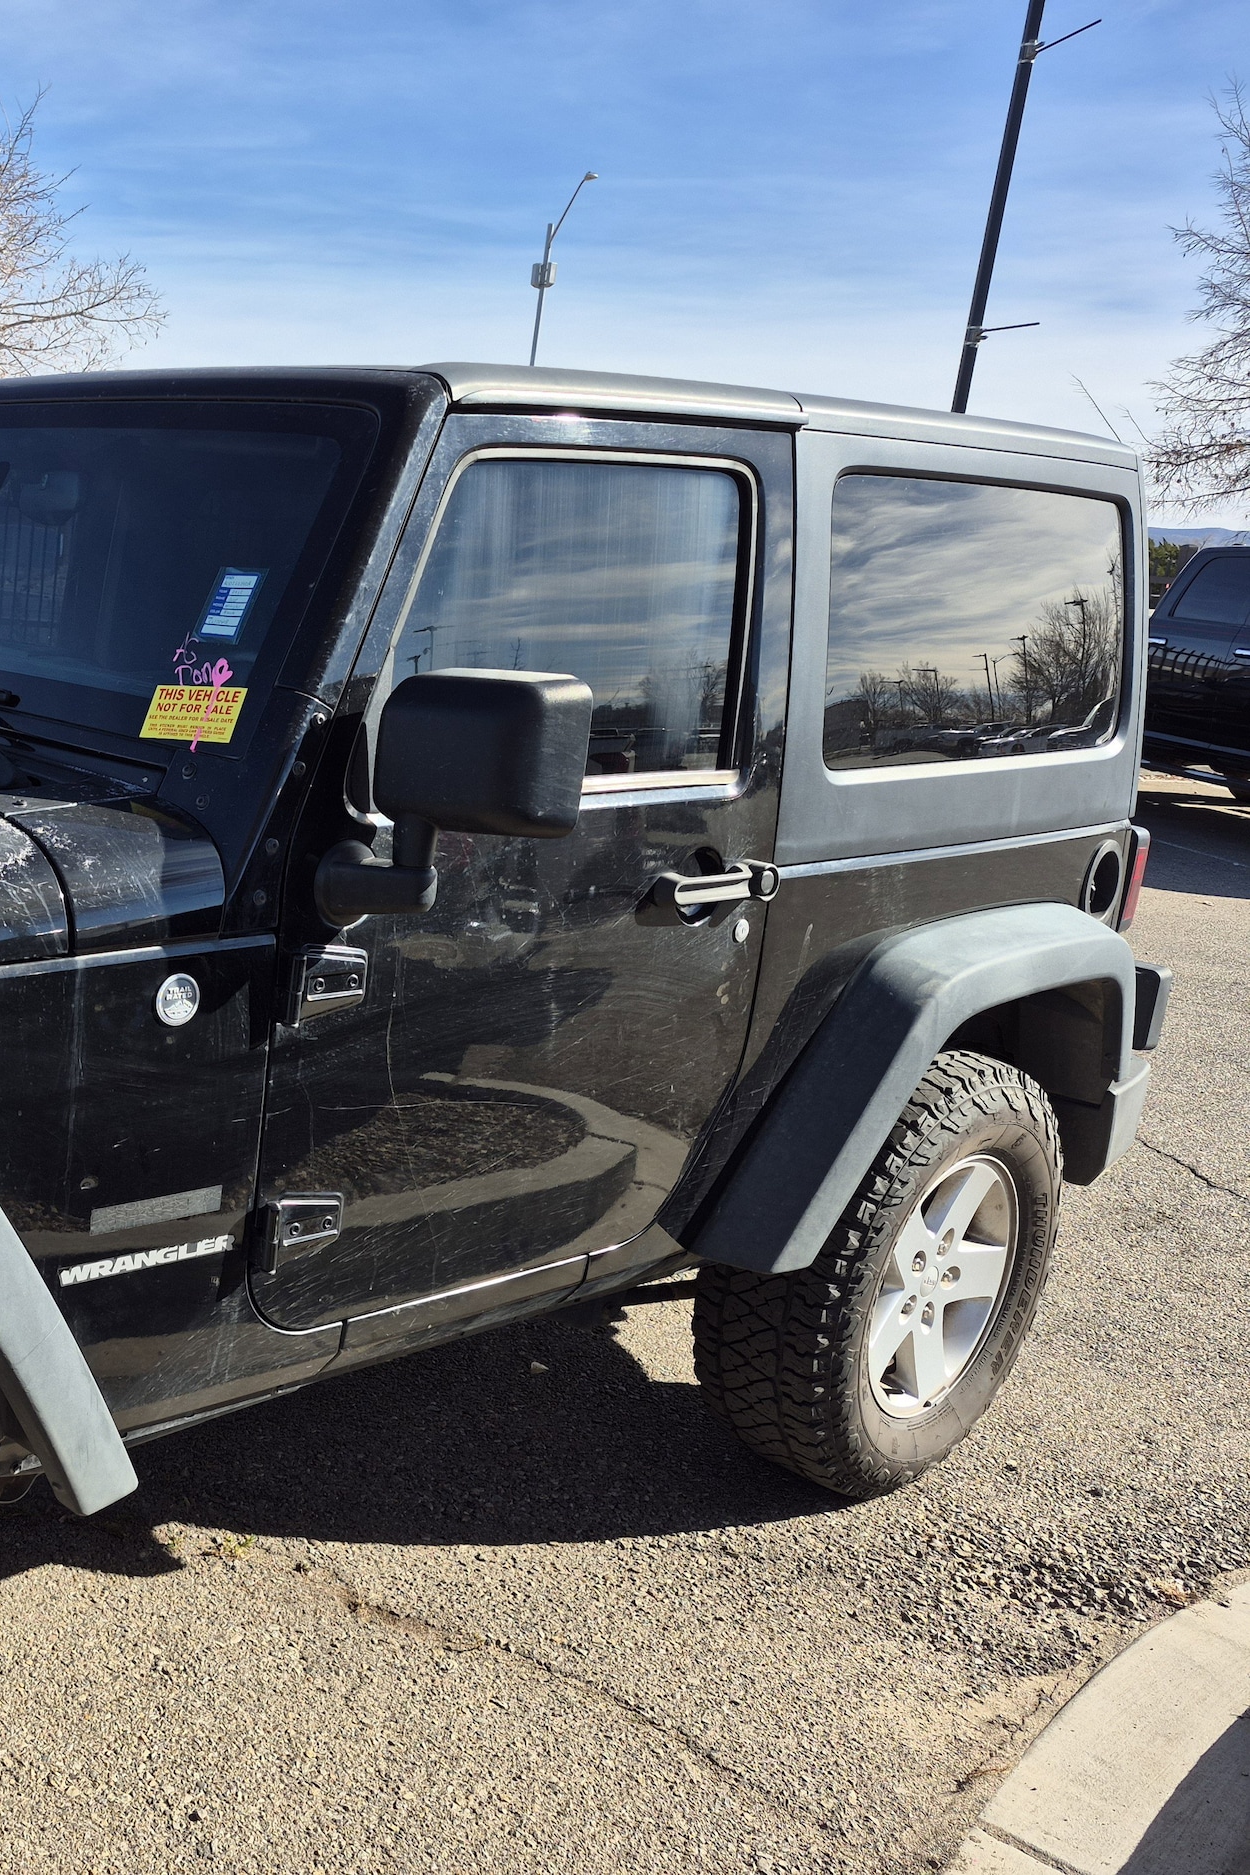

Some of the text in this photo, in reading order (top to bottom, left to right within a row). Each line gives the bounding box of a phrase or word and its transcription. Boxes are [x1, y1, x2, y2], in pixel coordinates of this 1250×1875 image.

[158, 688, 241, 703] THIS VEHCLE
[155, 702, 177, 712] NOT
[179, 703, 202, 713] FOR
[166, 992, 193, 1001] RATED
[168, 986, 192, 994] TRAIL
[60, 1234, 235, 1287] WRANGLER
[991, 1192, 1048, 1379] THUNDERER
